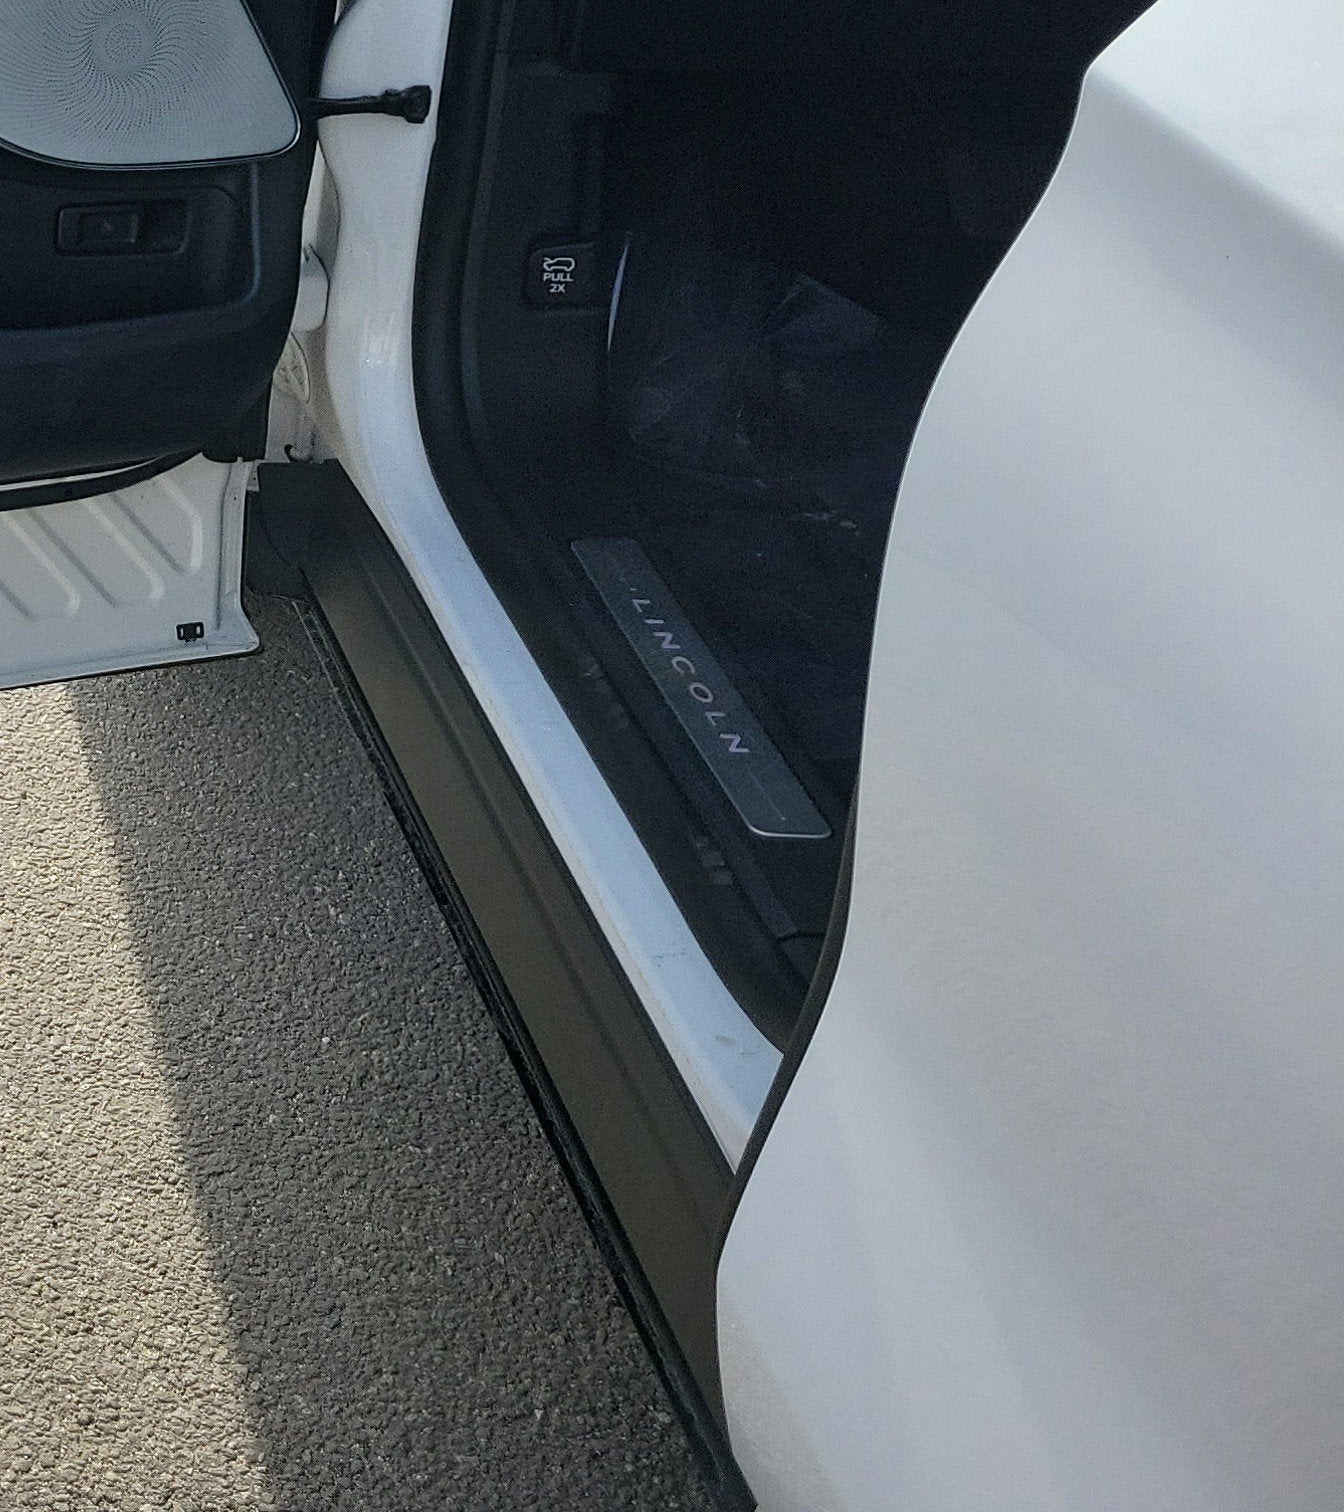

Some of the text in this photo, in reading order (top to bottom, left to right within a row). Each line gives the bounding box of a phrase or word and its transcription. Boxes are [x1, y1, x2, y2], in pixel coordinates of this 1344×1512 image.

[543, 272, 574, 282] PULL
[549, 283, 566, 293] 2X
[632, 598, 750, 753] LINCOLN
